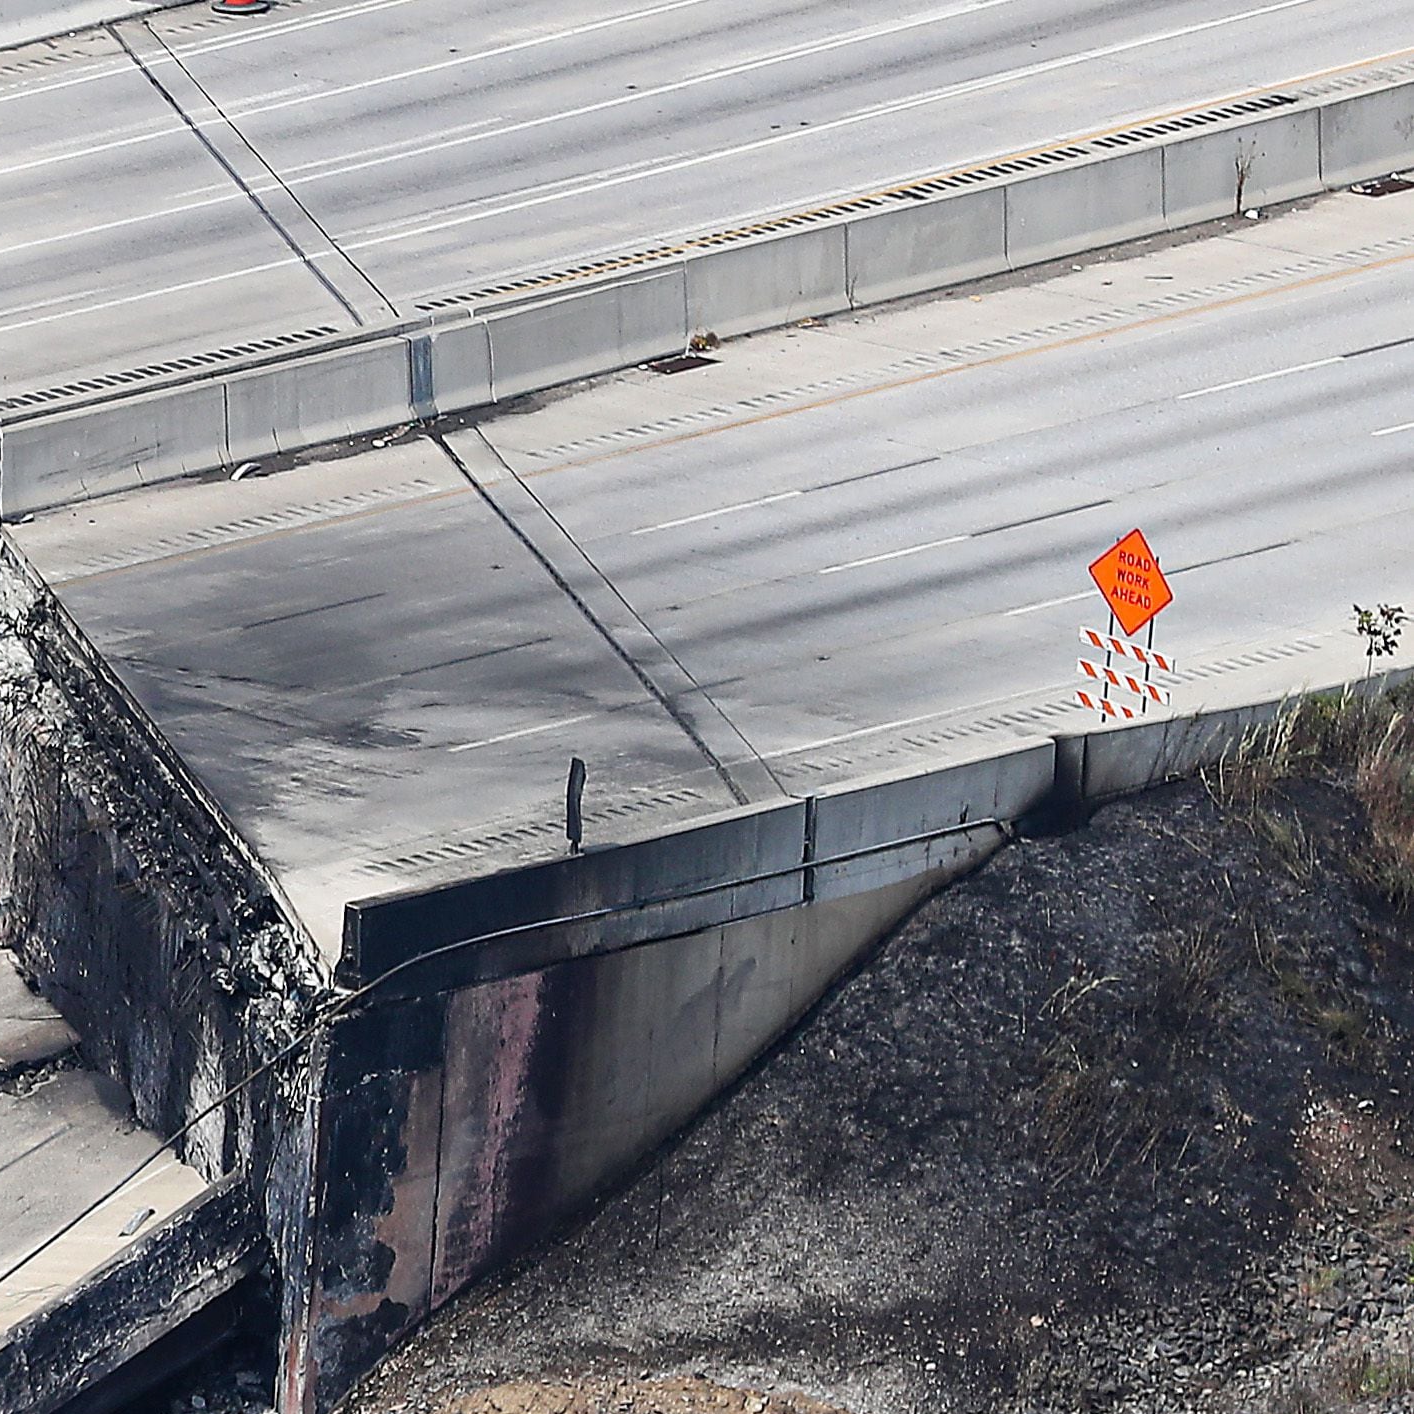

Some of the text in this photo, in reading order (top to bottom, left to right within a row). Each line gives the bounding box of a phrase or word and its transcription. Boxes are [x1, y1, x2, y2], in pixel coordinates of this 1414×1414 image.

[1119, 550, 1151, 572] ROAD
[1117, 568, 1149, 590] WORK
[1111, 585, 1151, 610] AHEAD
